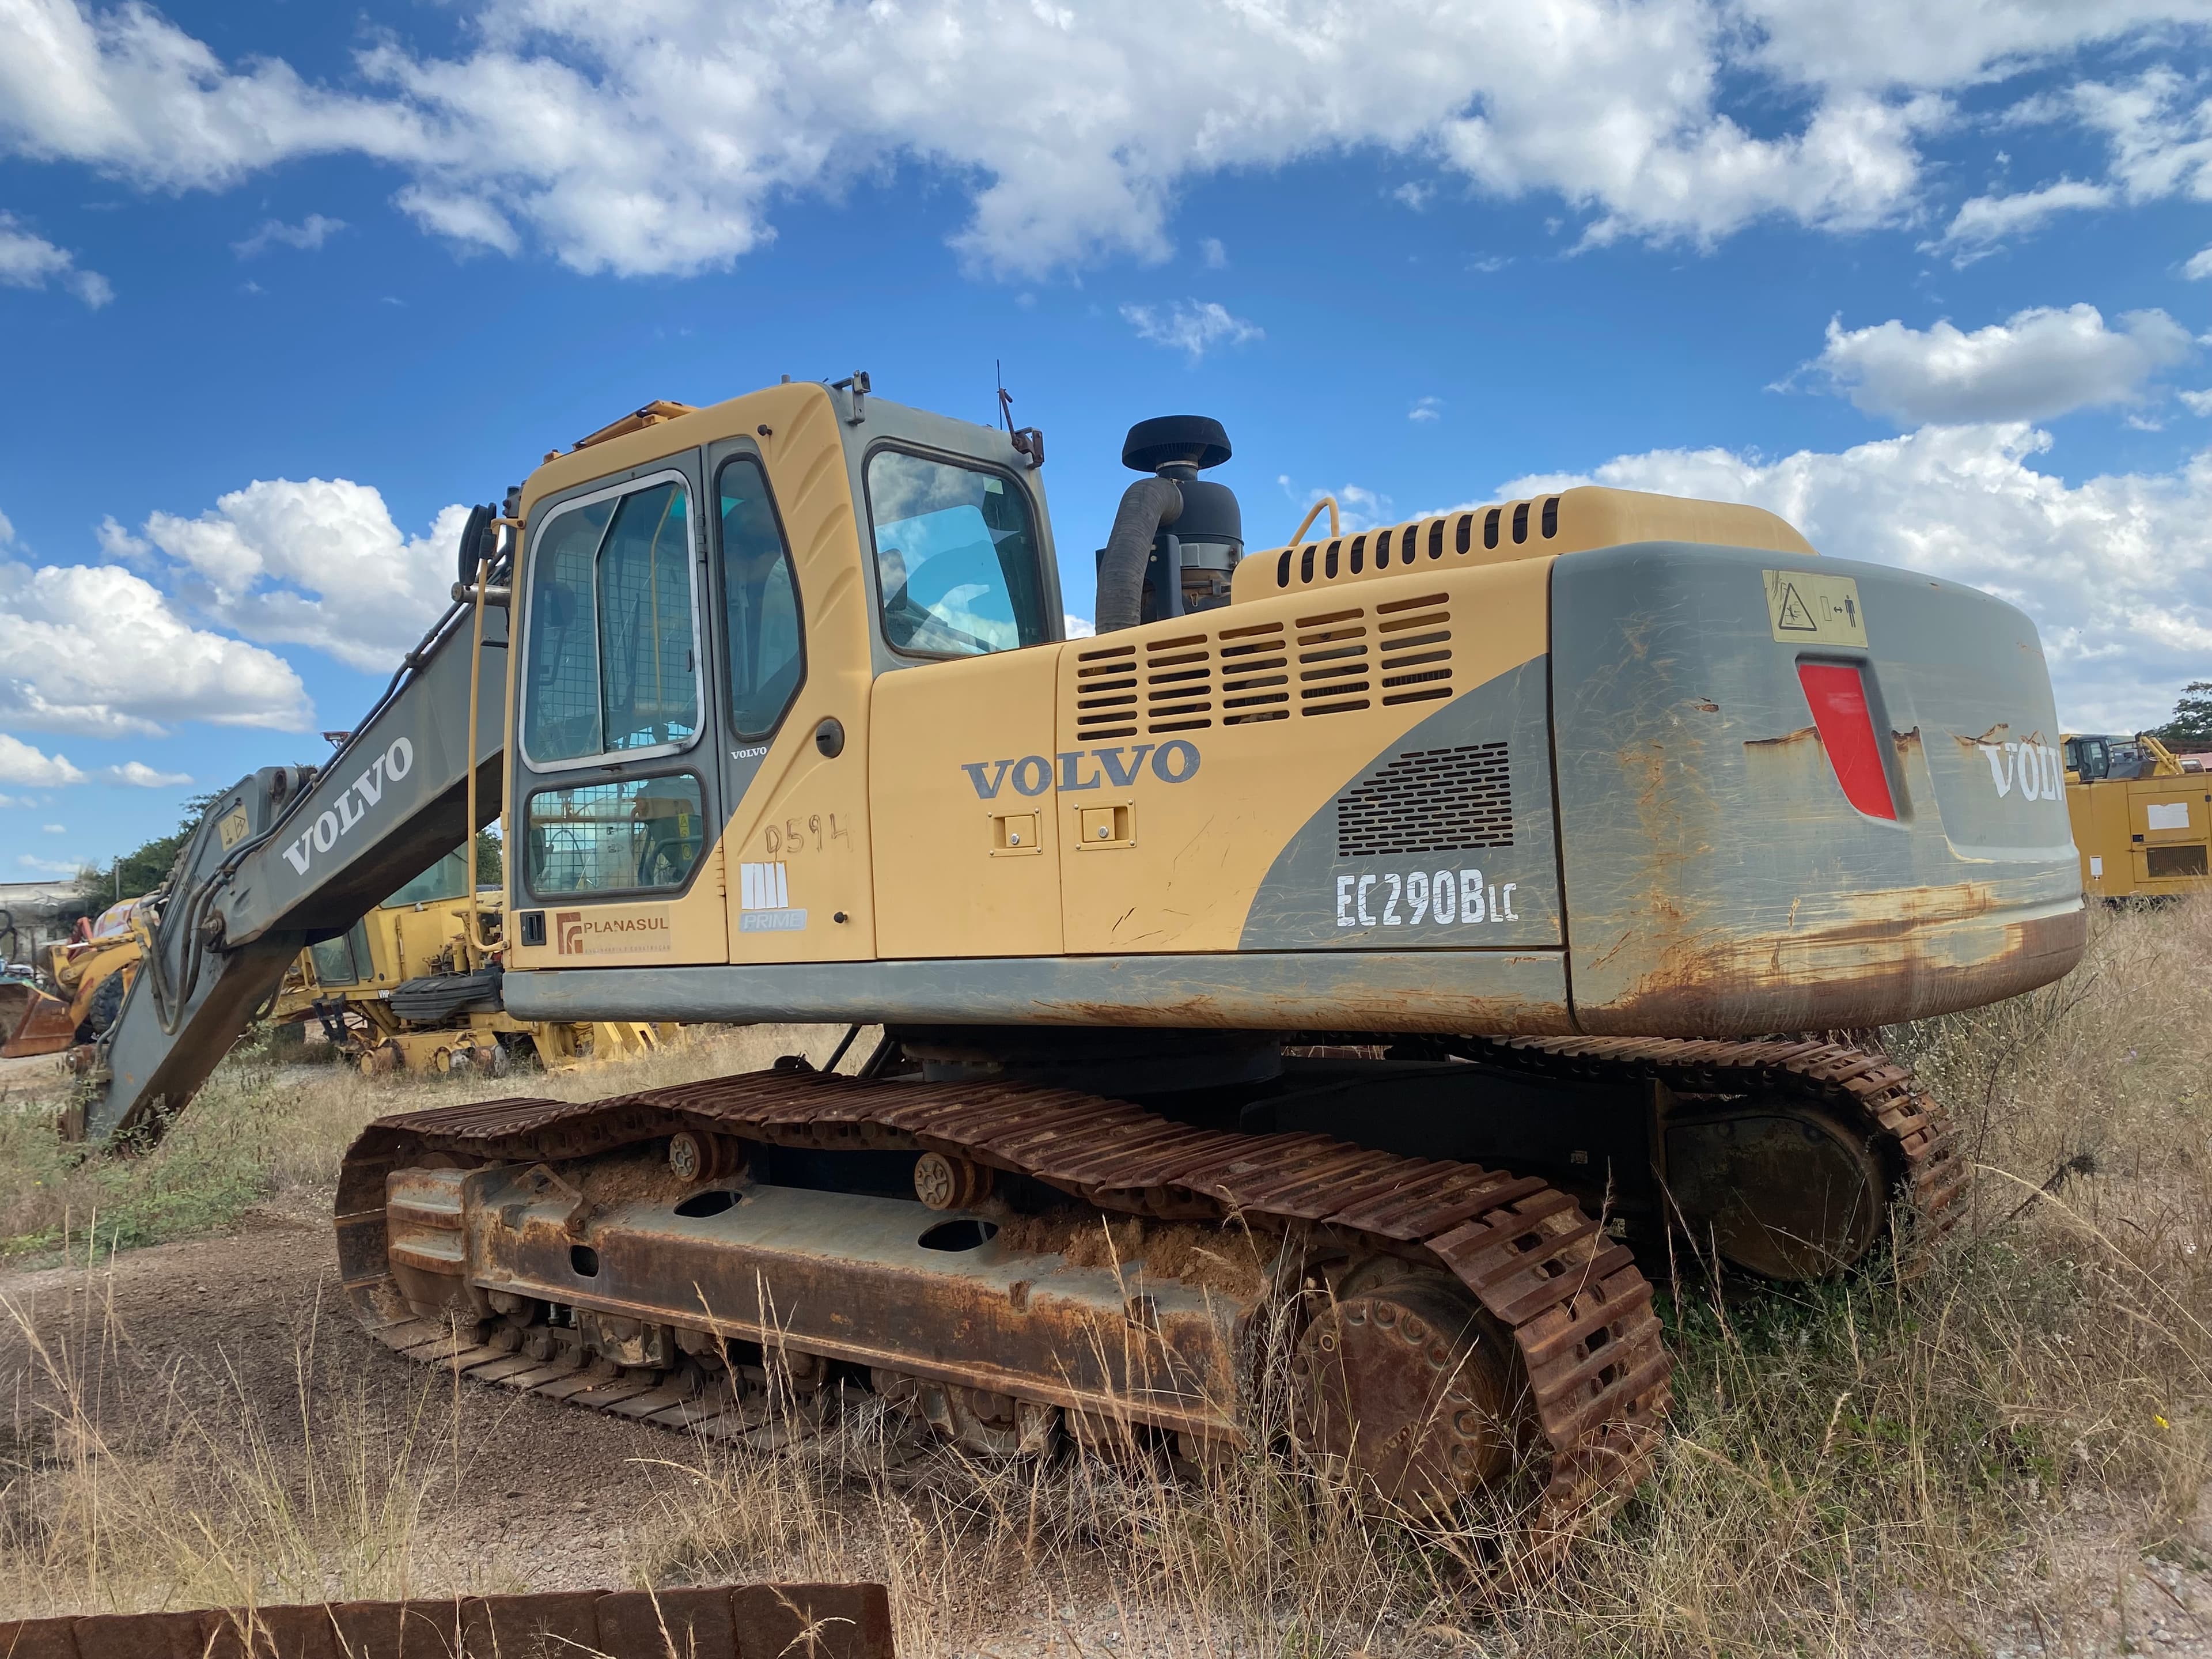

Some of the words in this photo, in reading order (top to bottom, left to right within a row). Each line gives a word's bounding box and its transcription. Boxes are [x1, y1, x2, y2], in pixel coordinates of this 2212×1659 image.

[730, 747, 767, 759] VOLVO
[961, 740, 1201, 799] VOLVO
[283, 737, 413, 876] VOLVO
[584, 918, 669, 934] PLANASUL
[744, 912, 801, 930] PRIME
[378, 990, 390, 998] VHP
